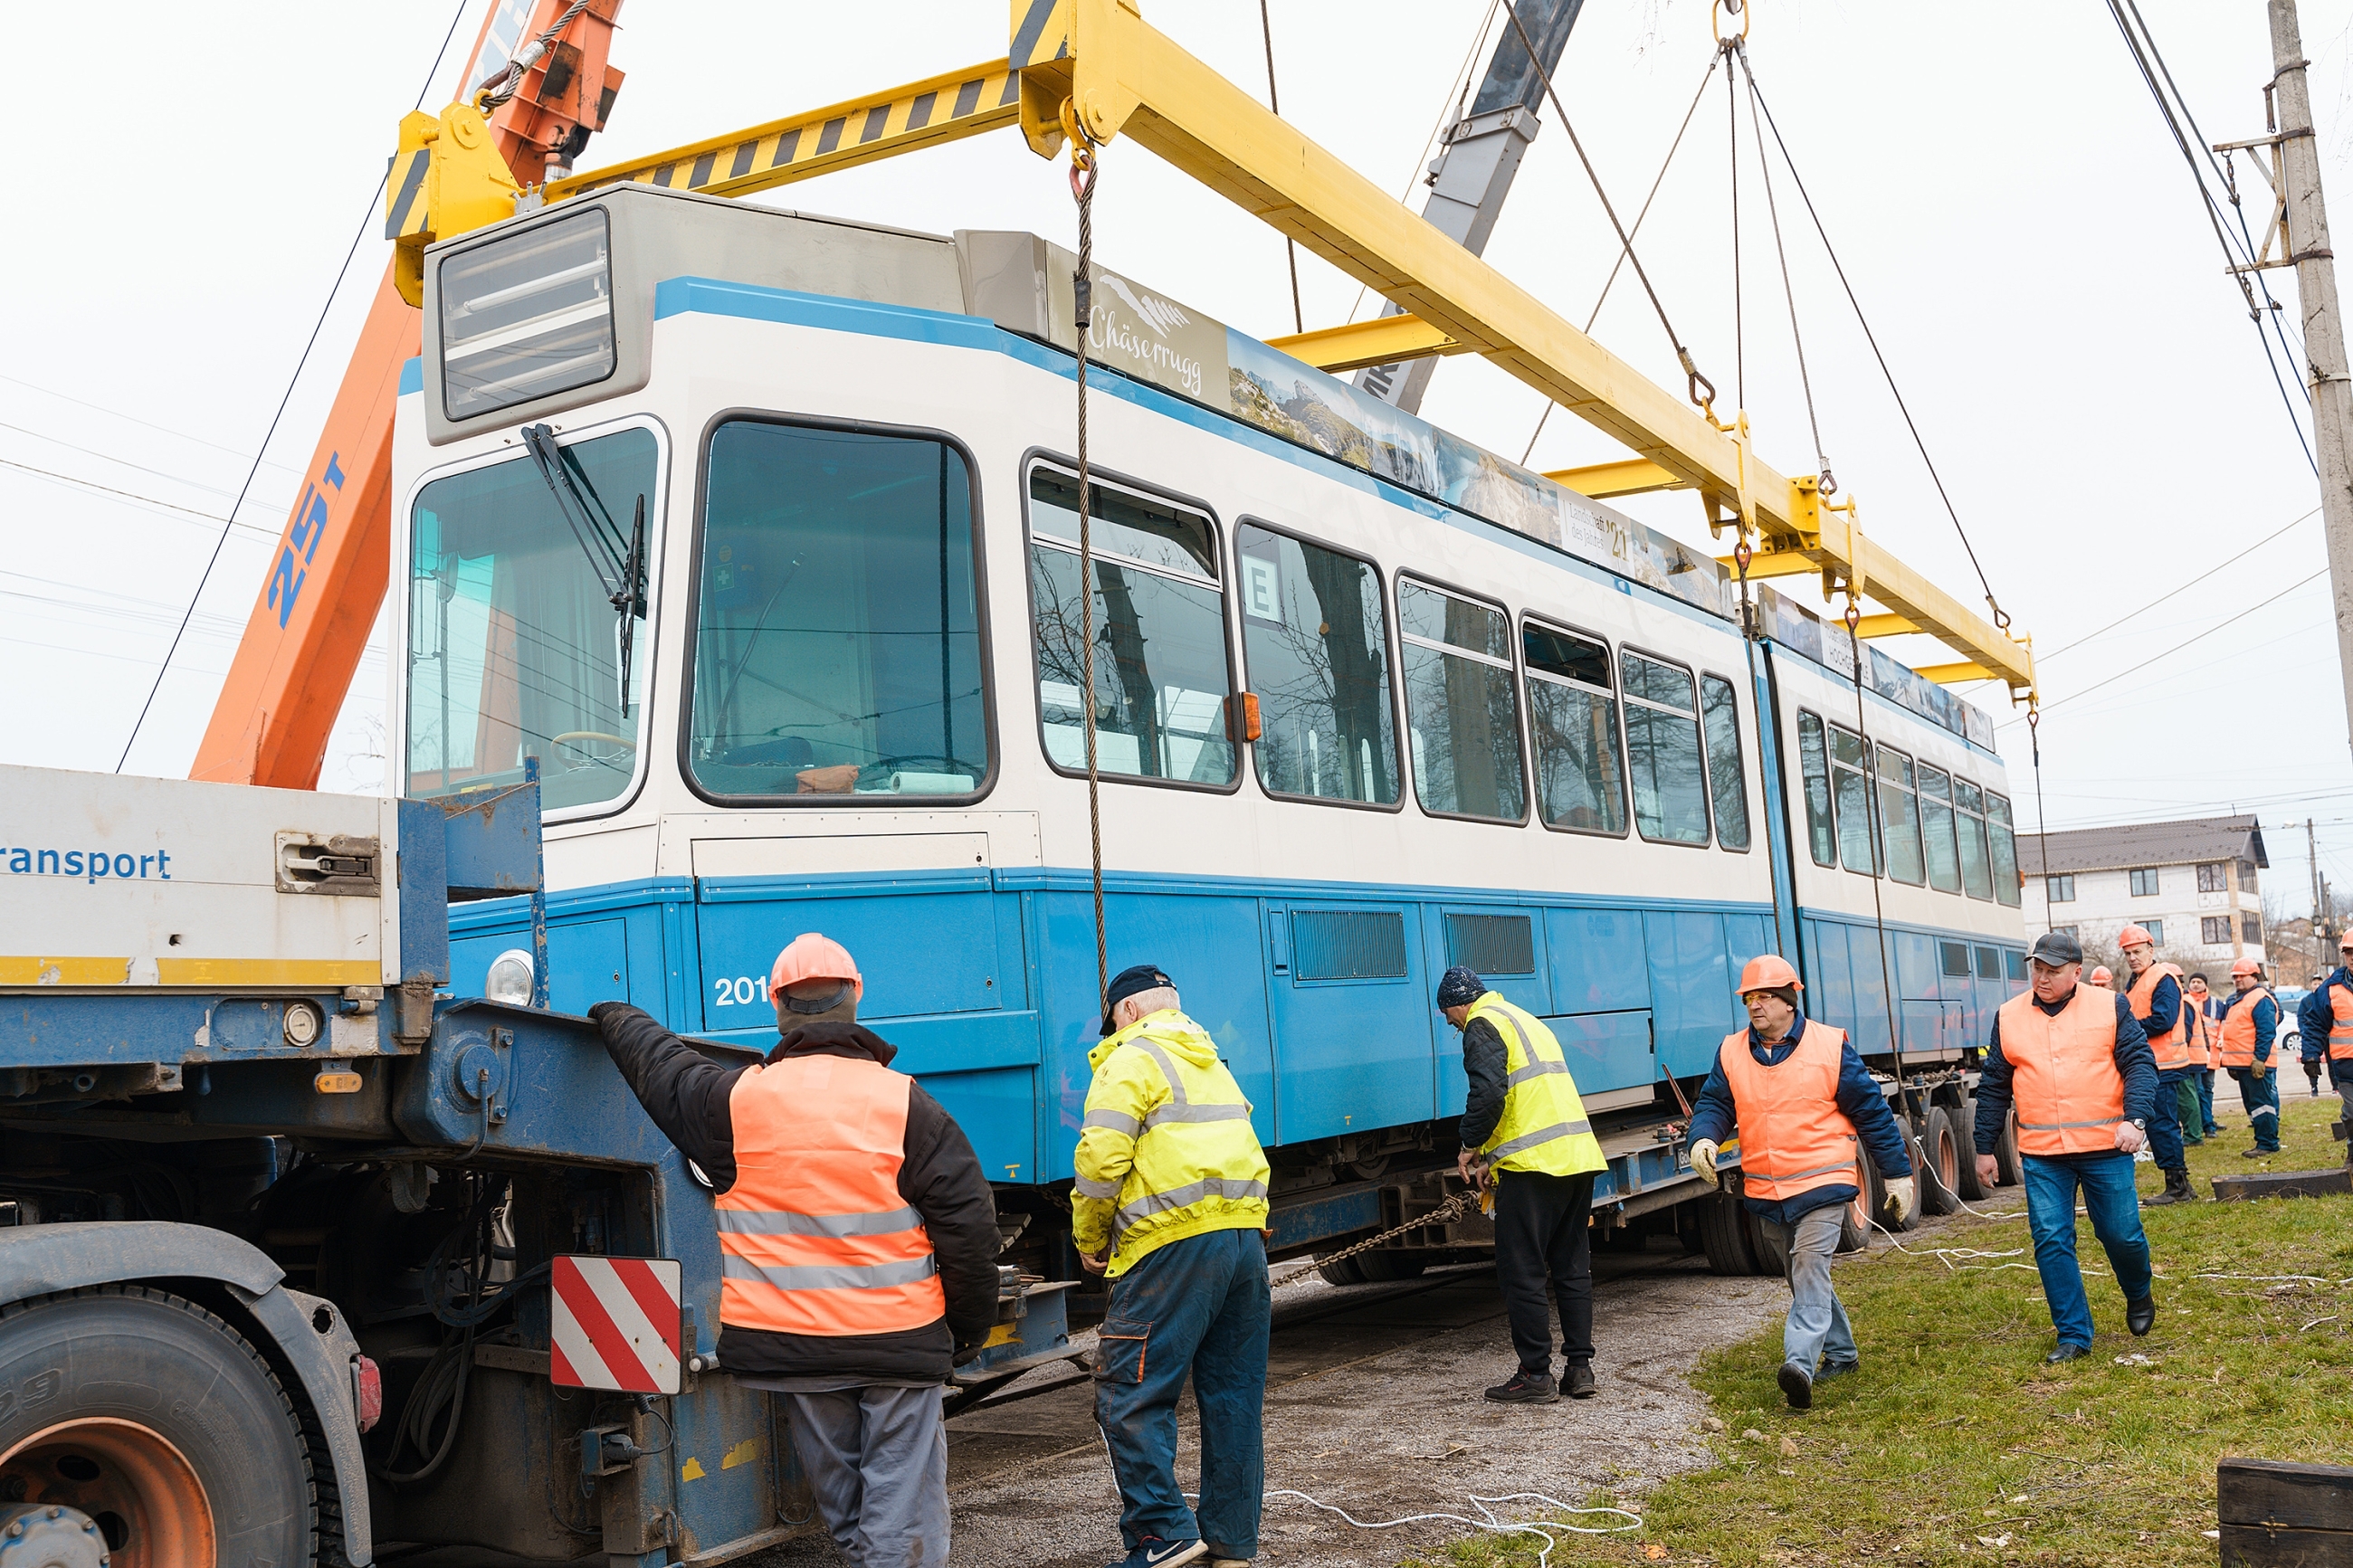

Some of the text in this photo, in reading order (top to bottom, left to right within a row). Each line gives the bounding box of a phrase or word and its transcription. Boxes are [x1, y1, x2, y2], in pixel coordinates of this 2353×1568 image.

[1088, 305, 1202, 397] Chäserrugg
[1569, 502, 1605, 533] Landschaft
[1571, 522, 1584, 541] des
[1584, 527, 1604, 550] Jahres
[1251, 566, 1270, 613] E
